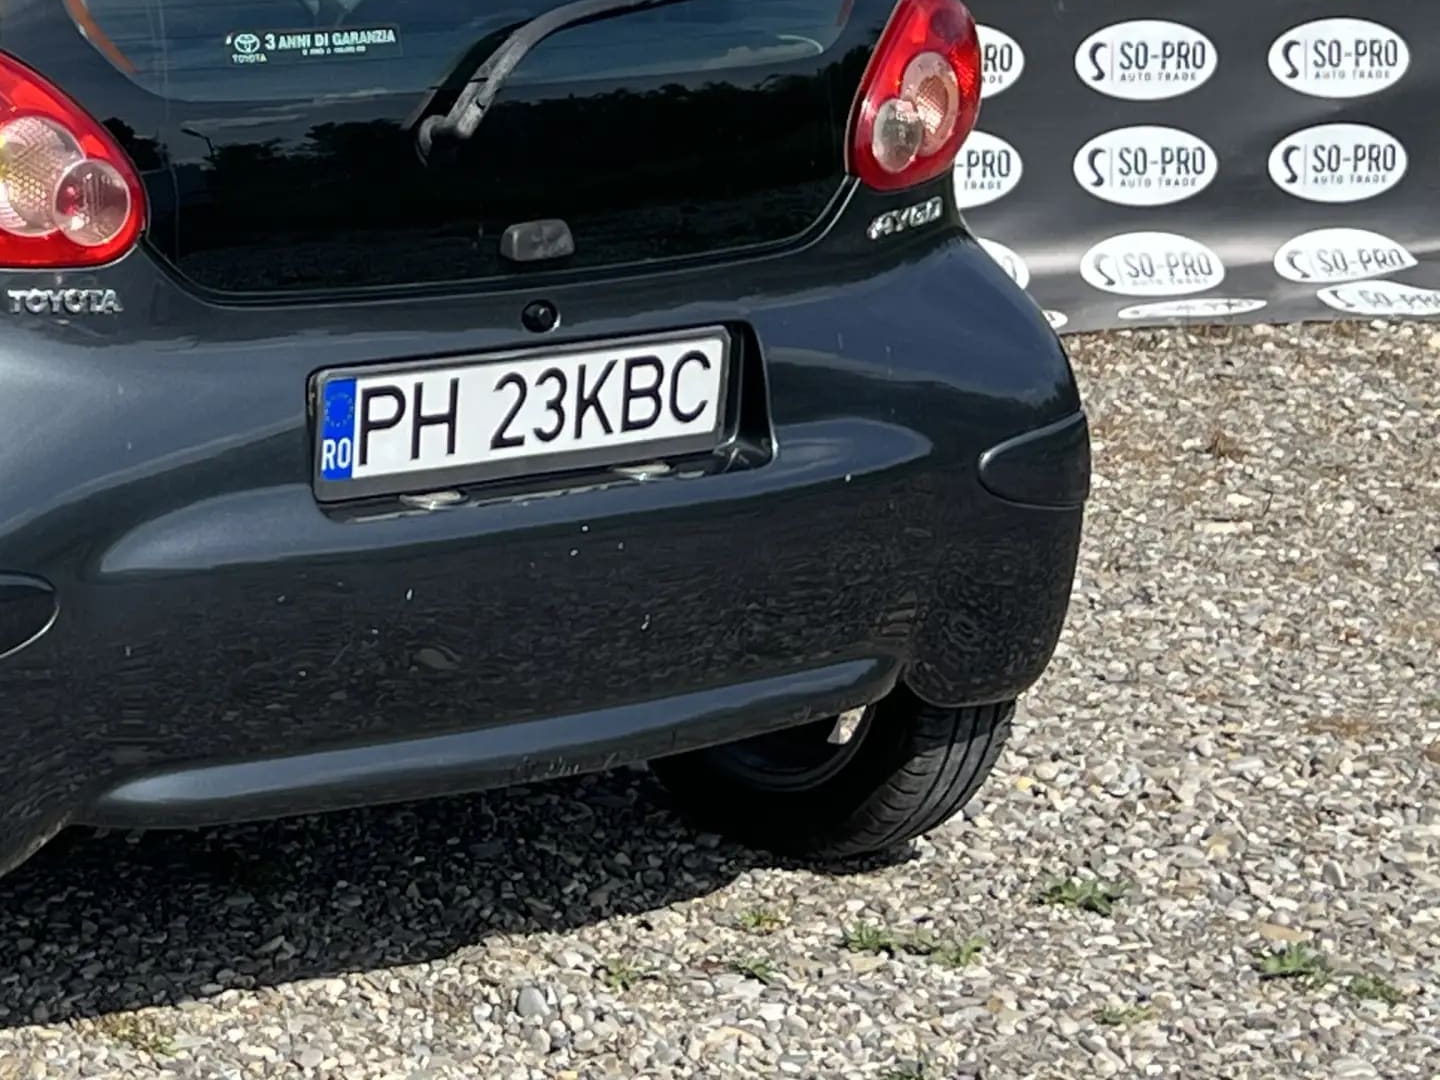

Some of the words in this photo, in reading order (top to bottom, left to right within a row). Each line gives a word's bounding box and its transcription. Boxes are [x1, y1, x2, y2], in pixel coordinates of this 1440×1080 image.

[265, 33, 276, 50] 3
[278, 34, 311, 50] ANNI
[315, 33, 329, 47] DI
[332, 29, 396, 46] GARANZIA
[1312, 39, 1398, 68] SO-PRO
[231, 53, 267, 63] TOYOTA
[1119, 41, 1206, 70] SO-PRO
[1118, 146, 1206, 176] SO-PRO
[1312, 143, 1396, 173] SO-PRO
[1123, 252, 1213, 278] SO-PRO
[7, 288, 124, 314] TOYOTA
[358, 377, 460, 467] PH
[490, 350, 711, 451] 23KBC
[322, 437, 352, 471] RO
